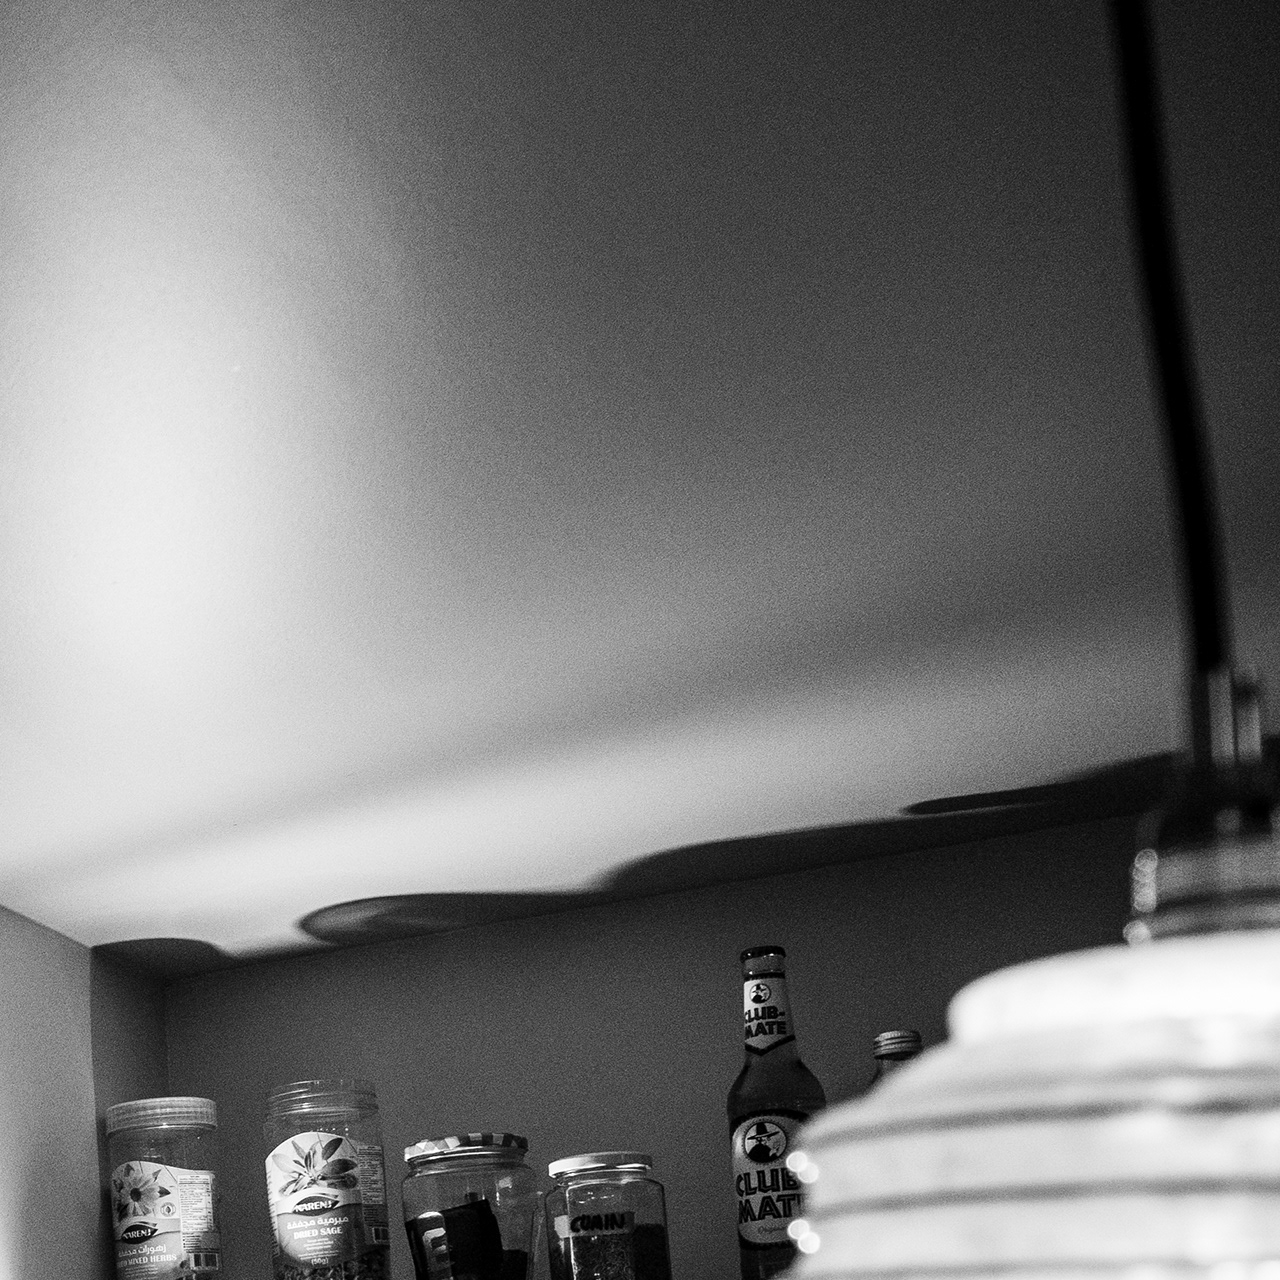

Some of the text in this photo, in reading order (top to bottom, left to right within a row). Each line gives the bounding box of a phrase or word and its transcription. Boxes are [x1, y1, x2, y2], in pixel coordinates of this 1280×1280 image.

[744, 1021, 787, 1039] MATE
[739, 1193, 805, 1224] MAT
[293, 1226, 344, 1240] DRIED SAGE
[150, 1253, 178, 1263] HERBS
